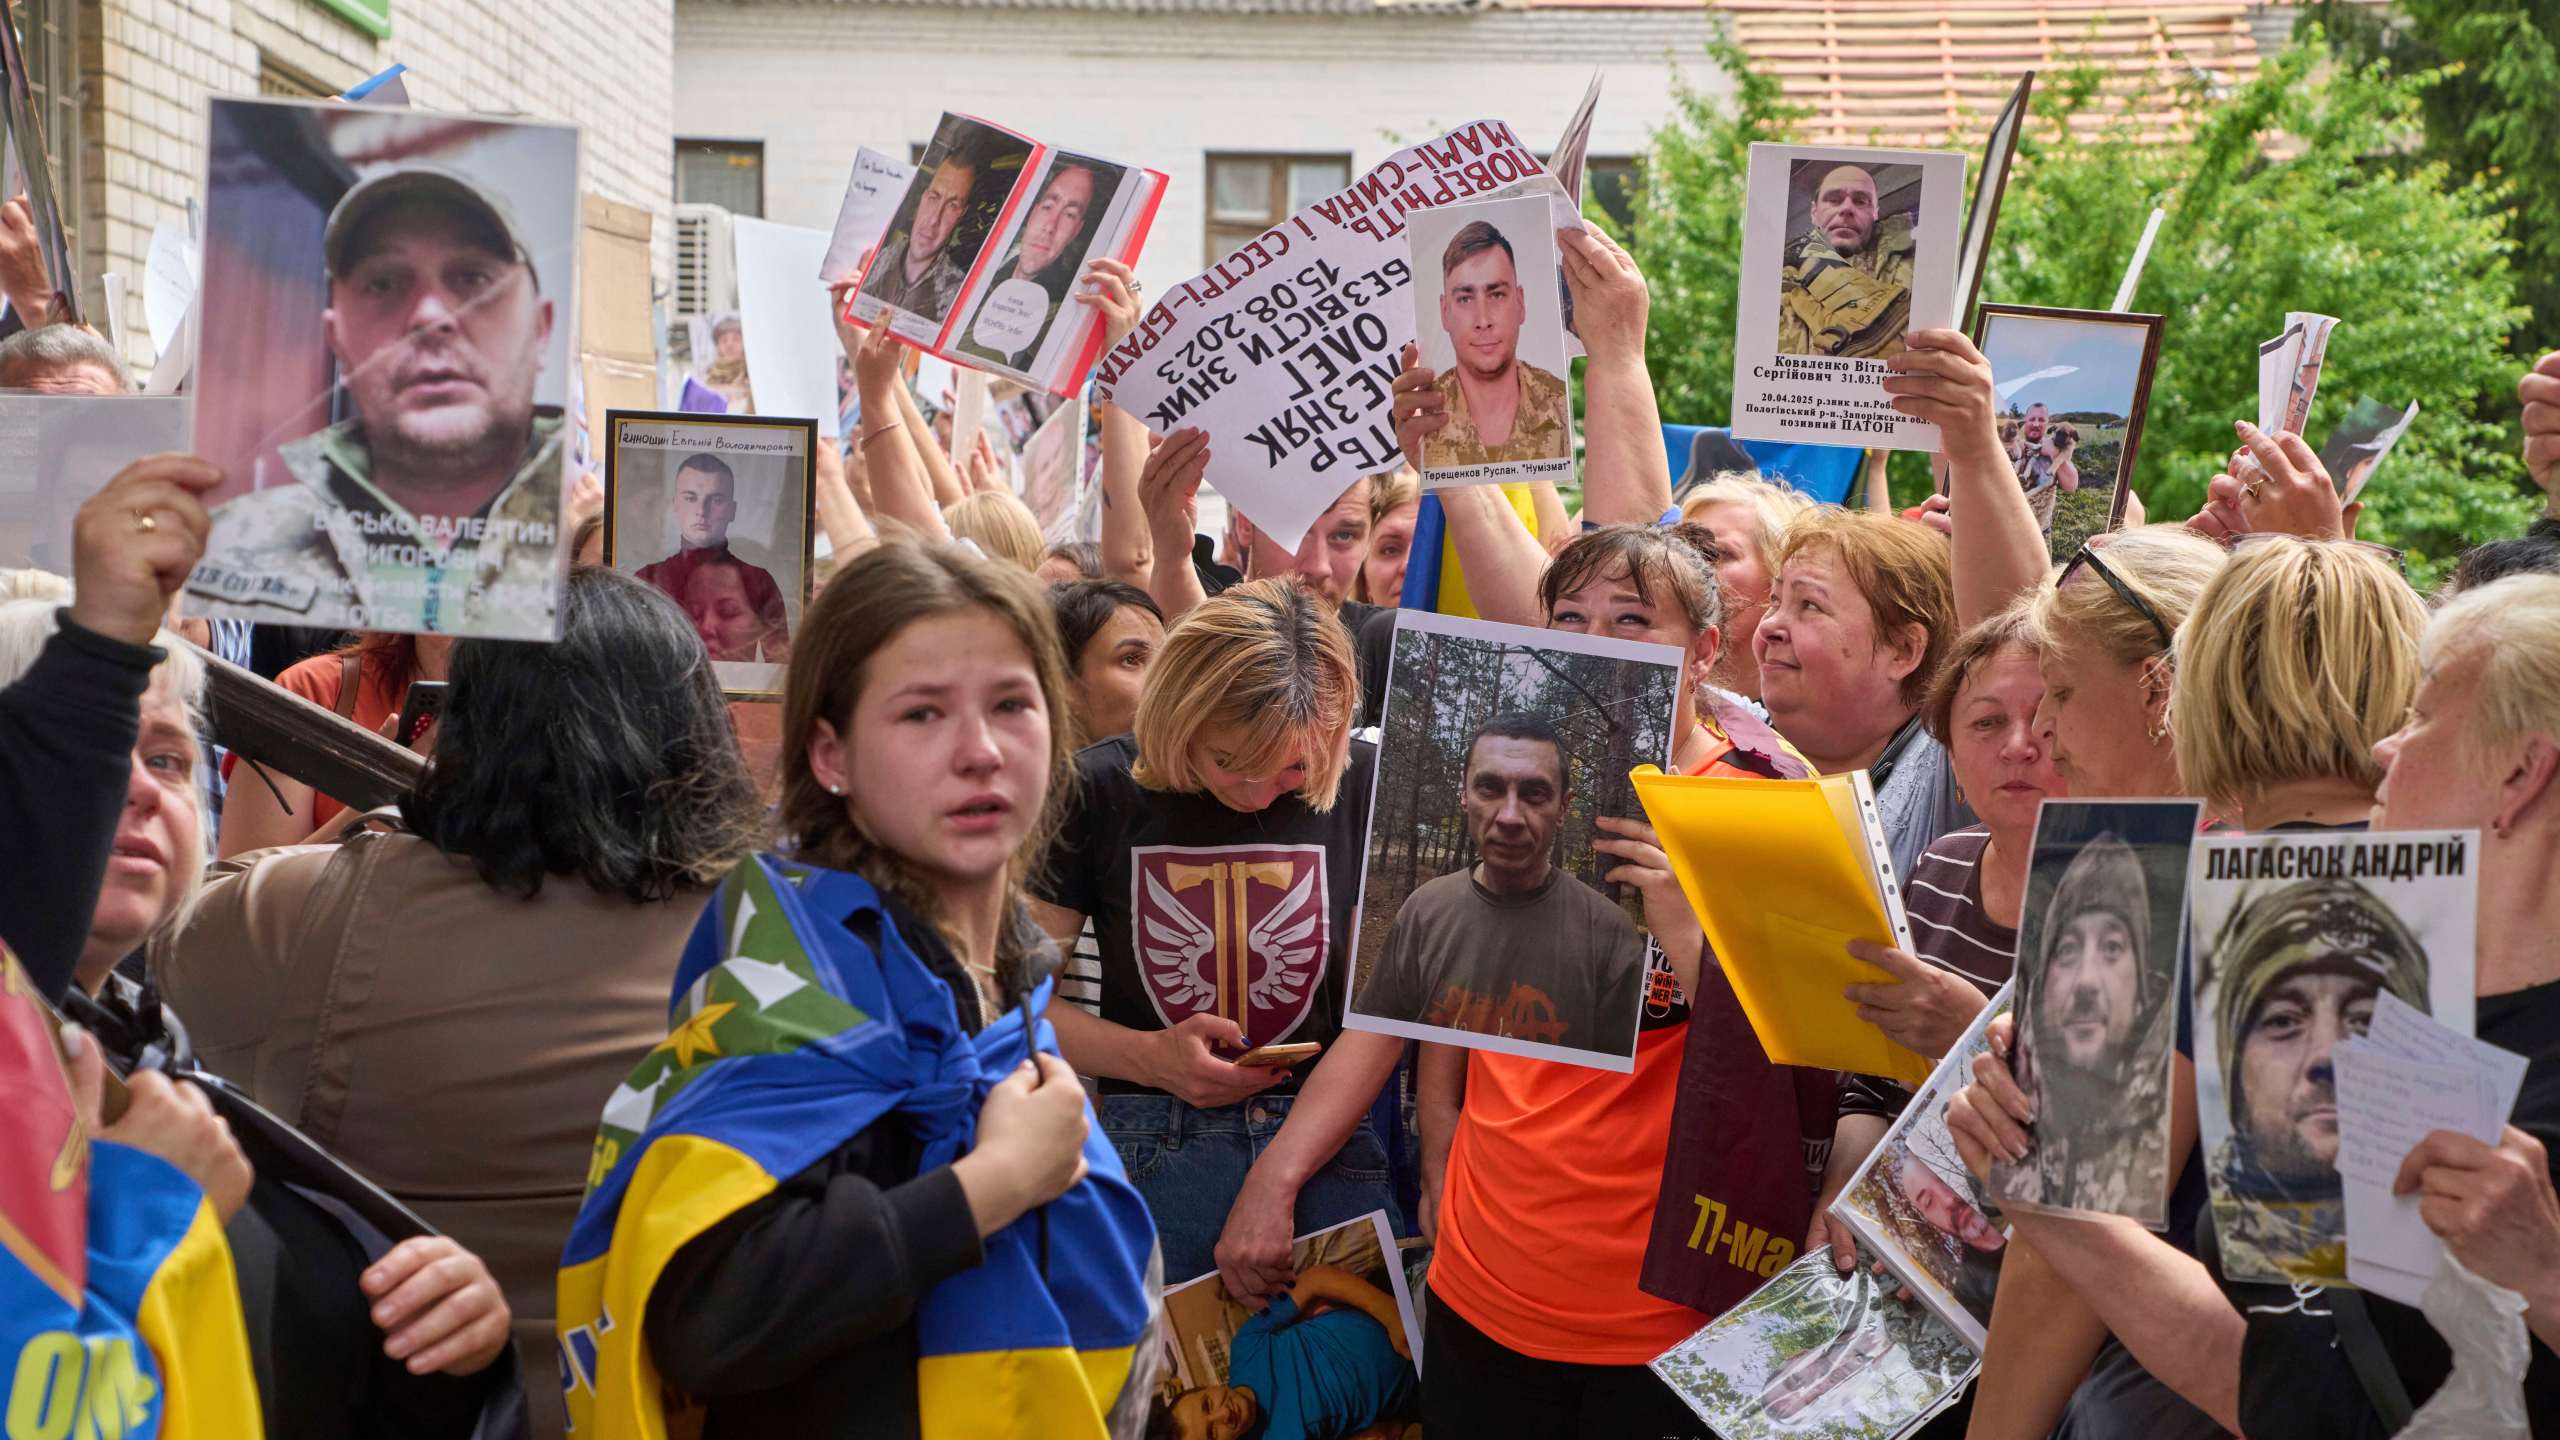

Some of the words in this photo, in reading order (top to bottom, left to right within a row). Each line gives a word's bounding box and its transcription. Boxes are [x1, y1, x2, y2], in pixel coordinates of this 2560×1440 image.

[1157, 258, 1341, 385] 15.08.2023
[1281, 312, 1388, 401] ОЛЕГ
[1774, 355, 1850, 371] Коваленко
[1855, 360, 1907, 375] Віта
[1753, 366, 1832, 381] Сергійович
[1146, 356, 1237, 432] ЗНИК
[1244, 340, 1414, 468] ЛЕЗНЯК
[1745, 403, 1817, 417] Пологівський
[1761, 393, 1814, 405] 20.04.2025
[1310, 408, 1402, 473] ТБР
[1780, 419, 1837, 430] позивний
[1842, 419, 1895, 434] ПАТОН
[1424, 467, 1480, 480] Терещенков
[1484, 465, 1518, 479] Руслан.
[1522, 460, 1571, 475] "Нумізмат"
[2206, 845, 2346, 880] ЛАГАСЮК
[2351, 835, 2466, 882] АНДРІЙ
